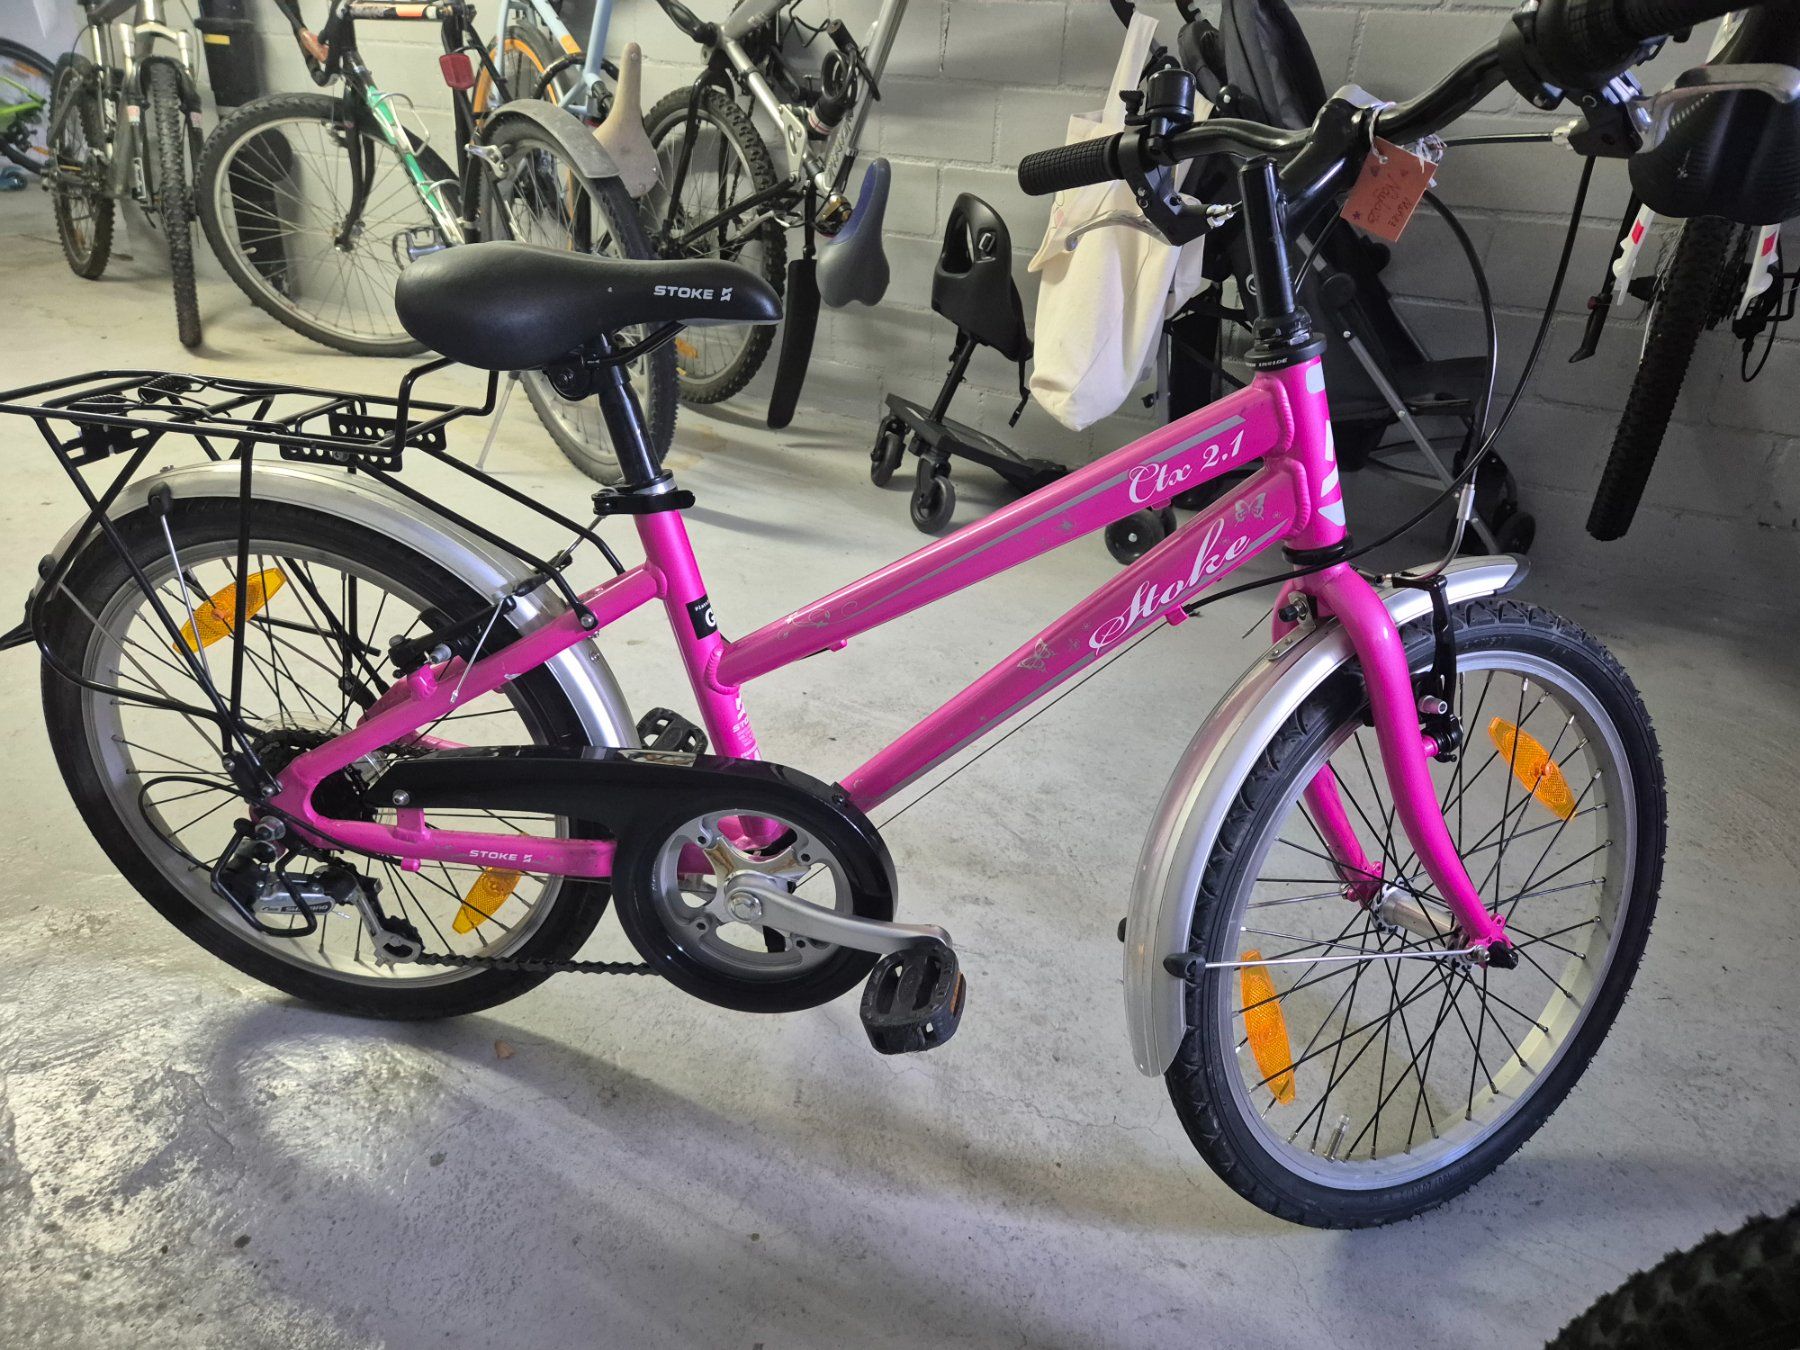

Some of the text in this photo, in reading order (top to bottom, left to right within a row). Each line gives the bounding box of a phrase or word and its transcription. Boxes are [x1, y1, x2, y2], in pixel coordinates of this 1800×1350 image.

[653, 285, 715, 300] STOKE
[1128, 429, 1245, 504] Ctx 2.1
[1088, 517, 1251, 656] Stoke
[469, 848, 518, 861] STOKE
